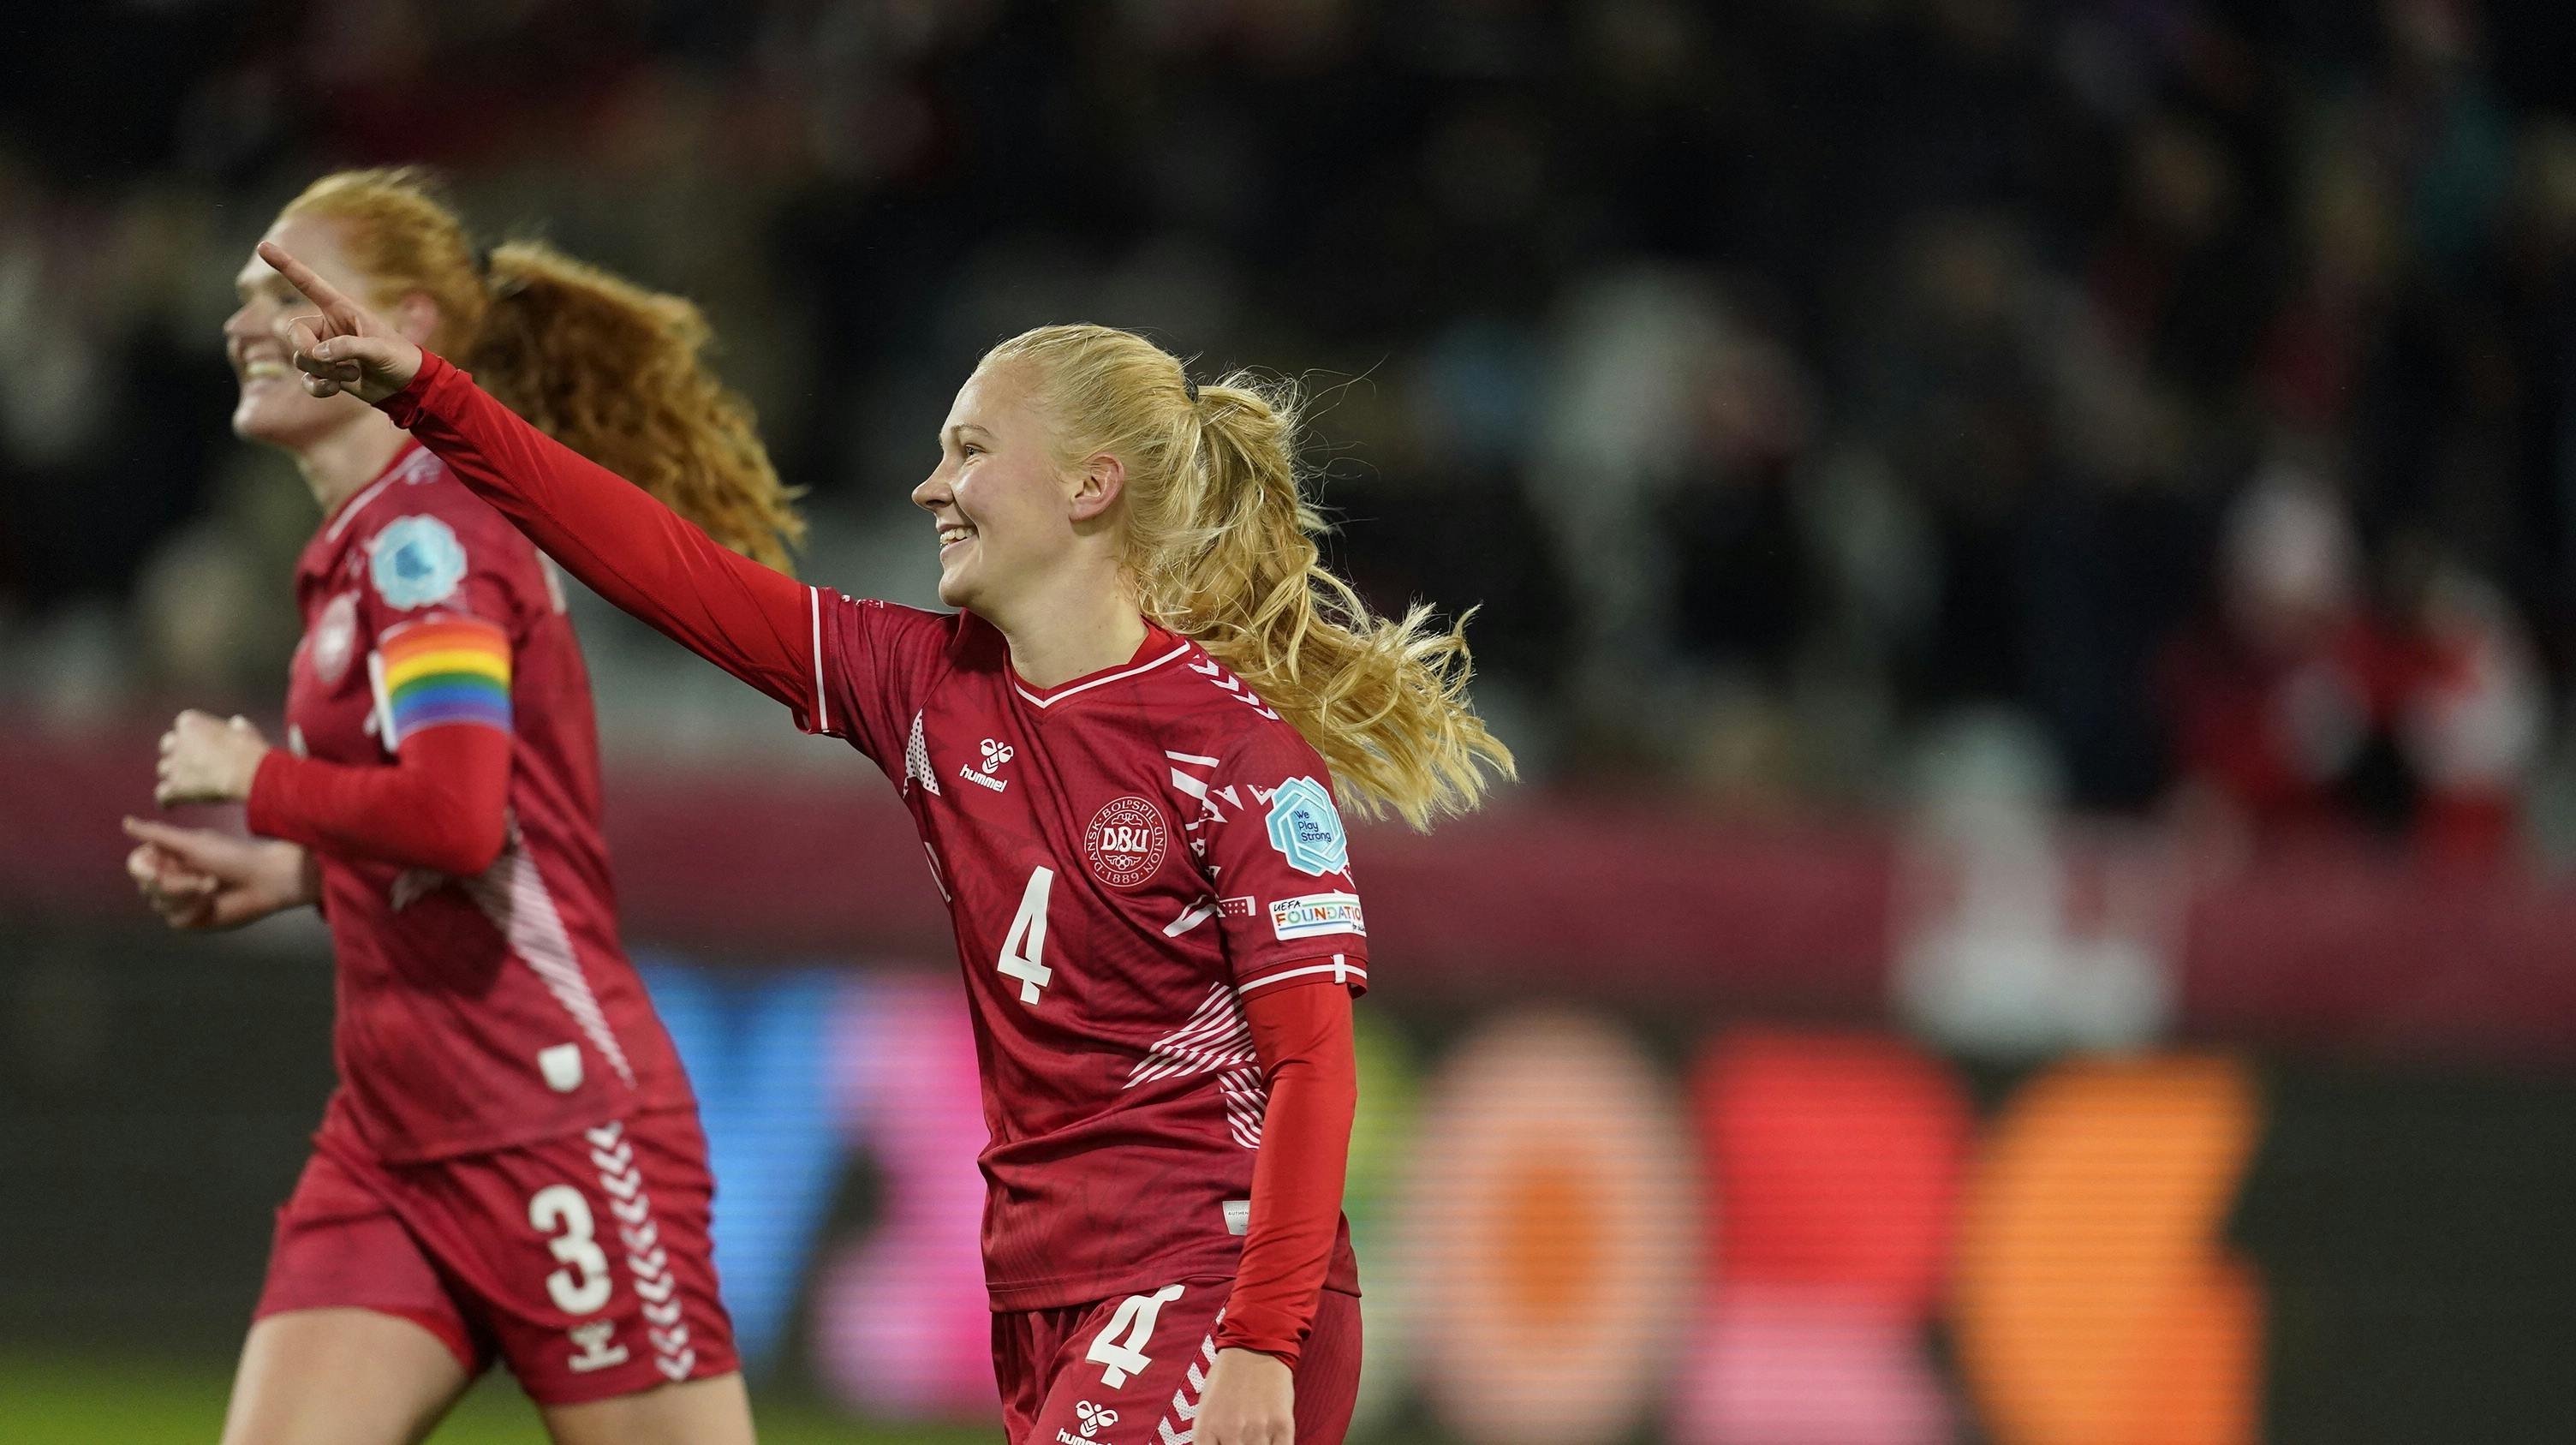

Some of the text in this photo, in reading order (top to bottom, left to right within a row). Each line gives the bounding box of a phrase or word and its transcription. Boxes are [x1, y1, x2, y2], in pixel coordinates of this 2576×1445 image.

[959, 763, 1008, 792] hummel
[1294, 810, 1309, 819] We
[1297, 821, 1319, 832] Play
[1302, 832, 1332, 842] Strong
[1087, 821, 1103, 872] DANSK
[1143, 827, 1165, 873] UNION
[1100, 826, 1149, 853] DBU
[1106, 872, 1139, 884] 1889
[1273, 900, 1301, 911] UEFA
[1275, 906, 1363, 926] FOUNDATIO
[997, 864, 1054, 1006] 4
[528, 1184, 613, 1315] 3
[1085, 1283, 1186, 1390] 4
